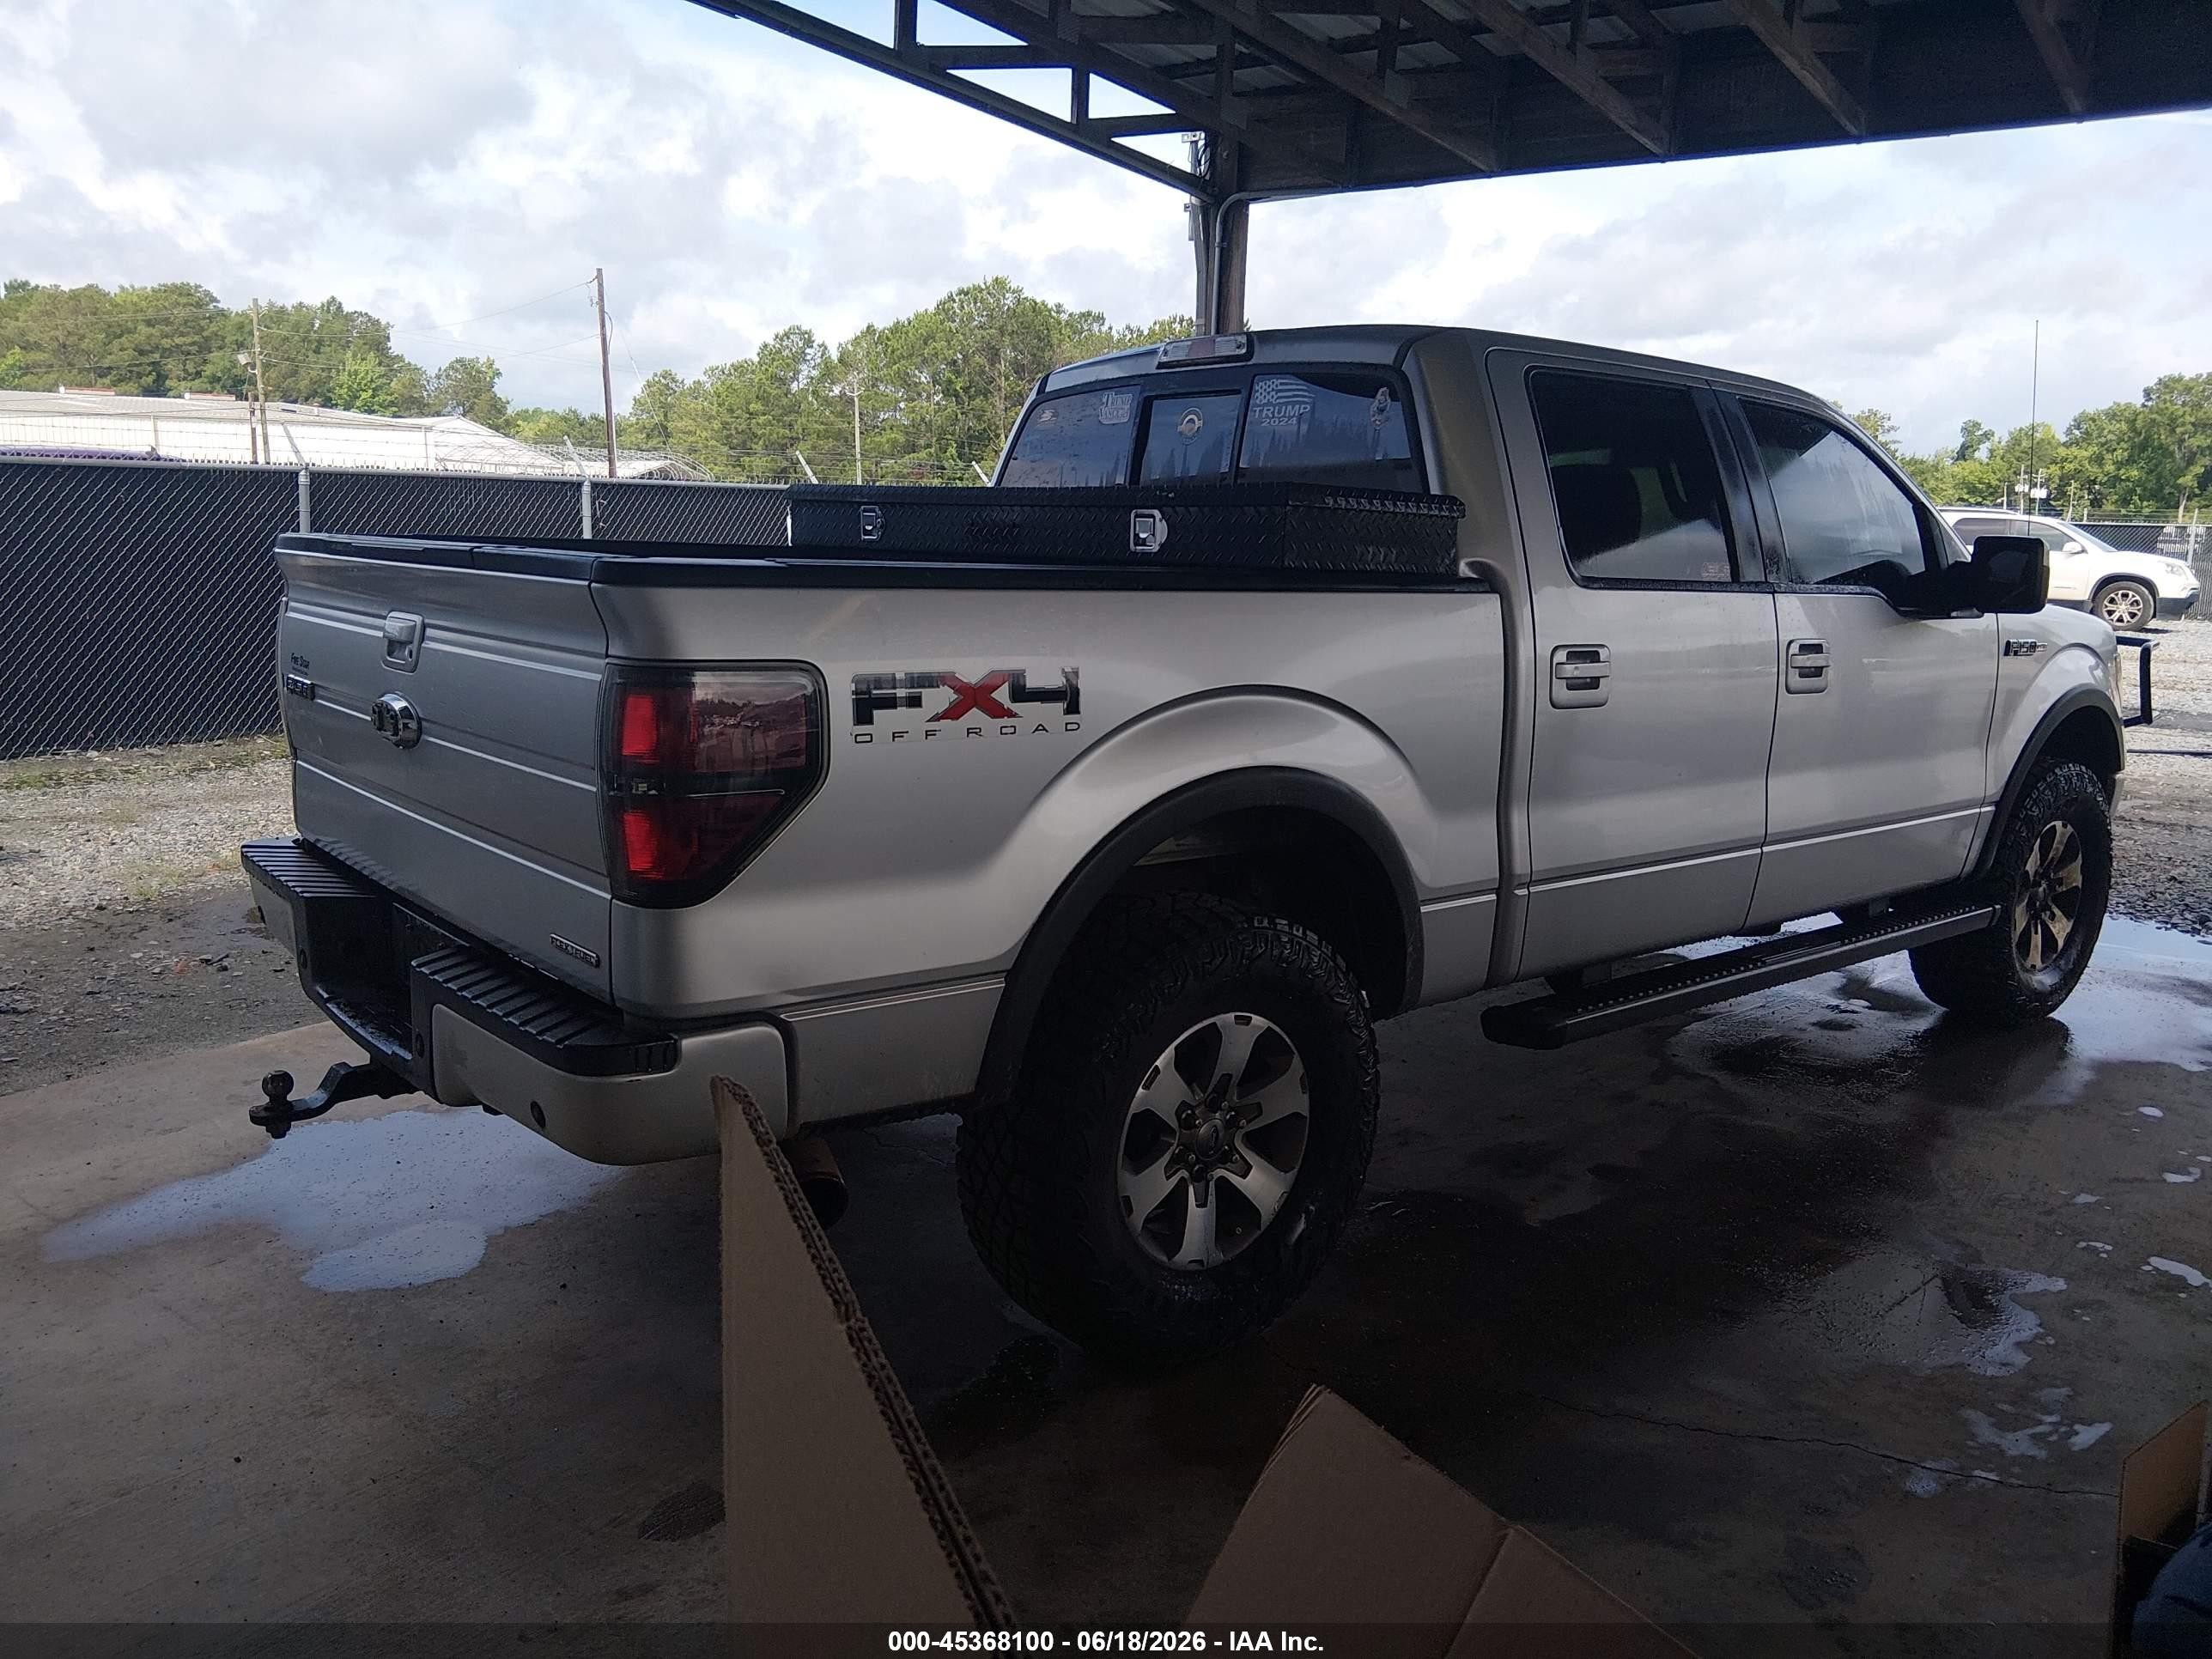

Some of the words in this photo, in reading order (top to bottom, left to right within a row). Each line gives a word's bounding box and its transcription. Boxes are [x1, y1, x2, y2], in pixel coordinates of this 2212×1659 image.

[1253, 404, 1310, 418] TRUMP
[1261, 417, 1297, 426] 2024
[851, 667, 1080, 726] FX4
[854, 731, 942, 744] OFF
[966, 722, 1080, 738] ROAD
